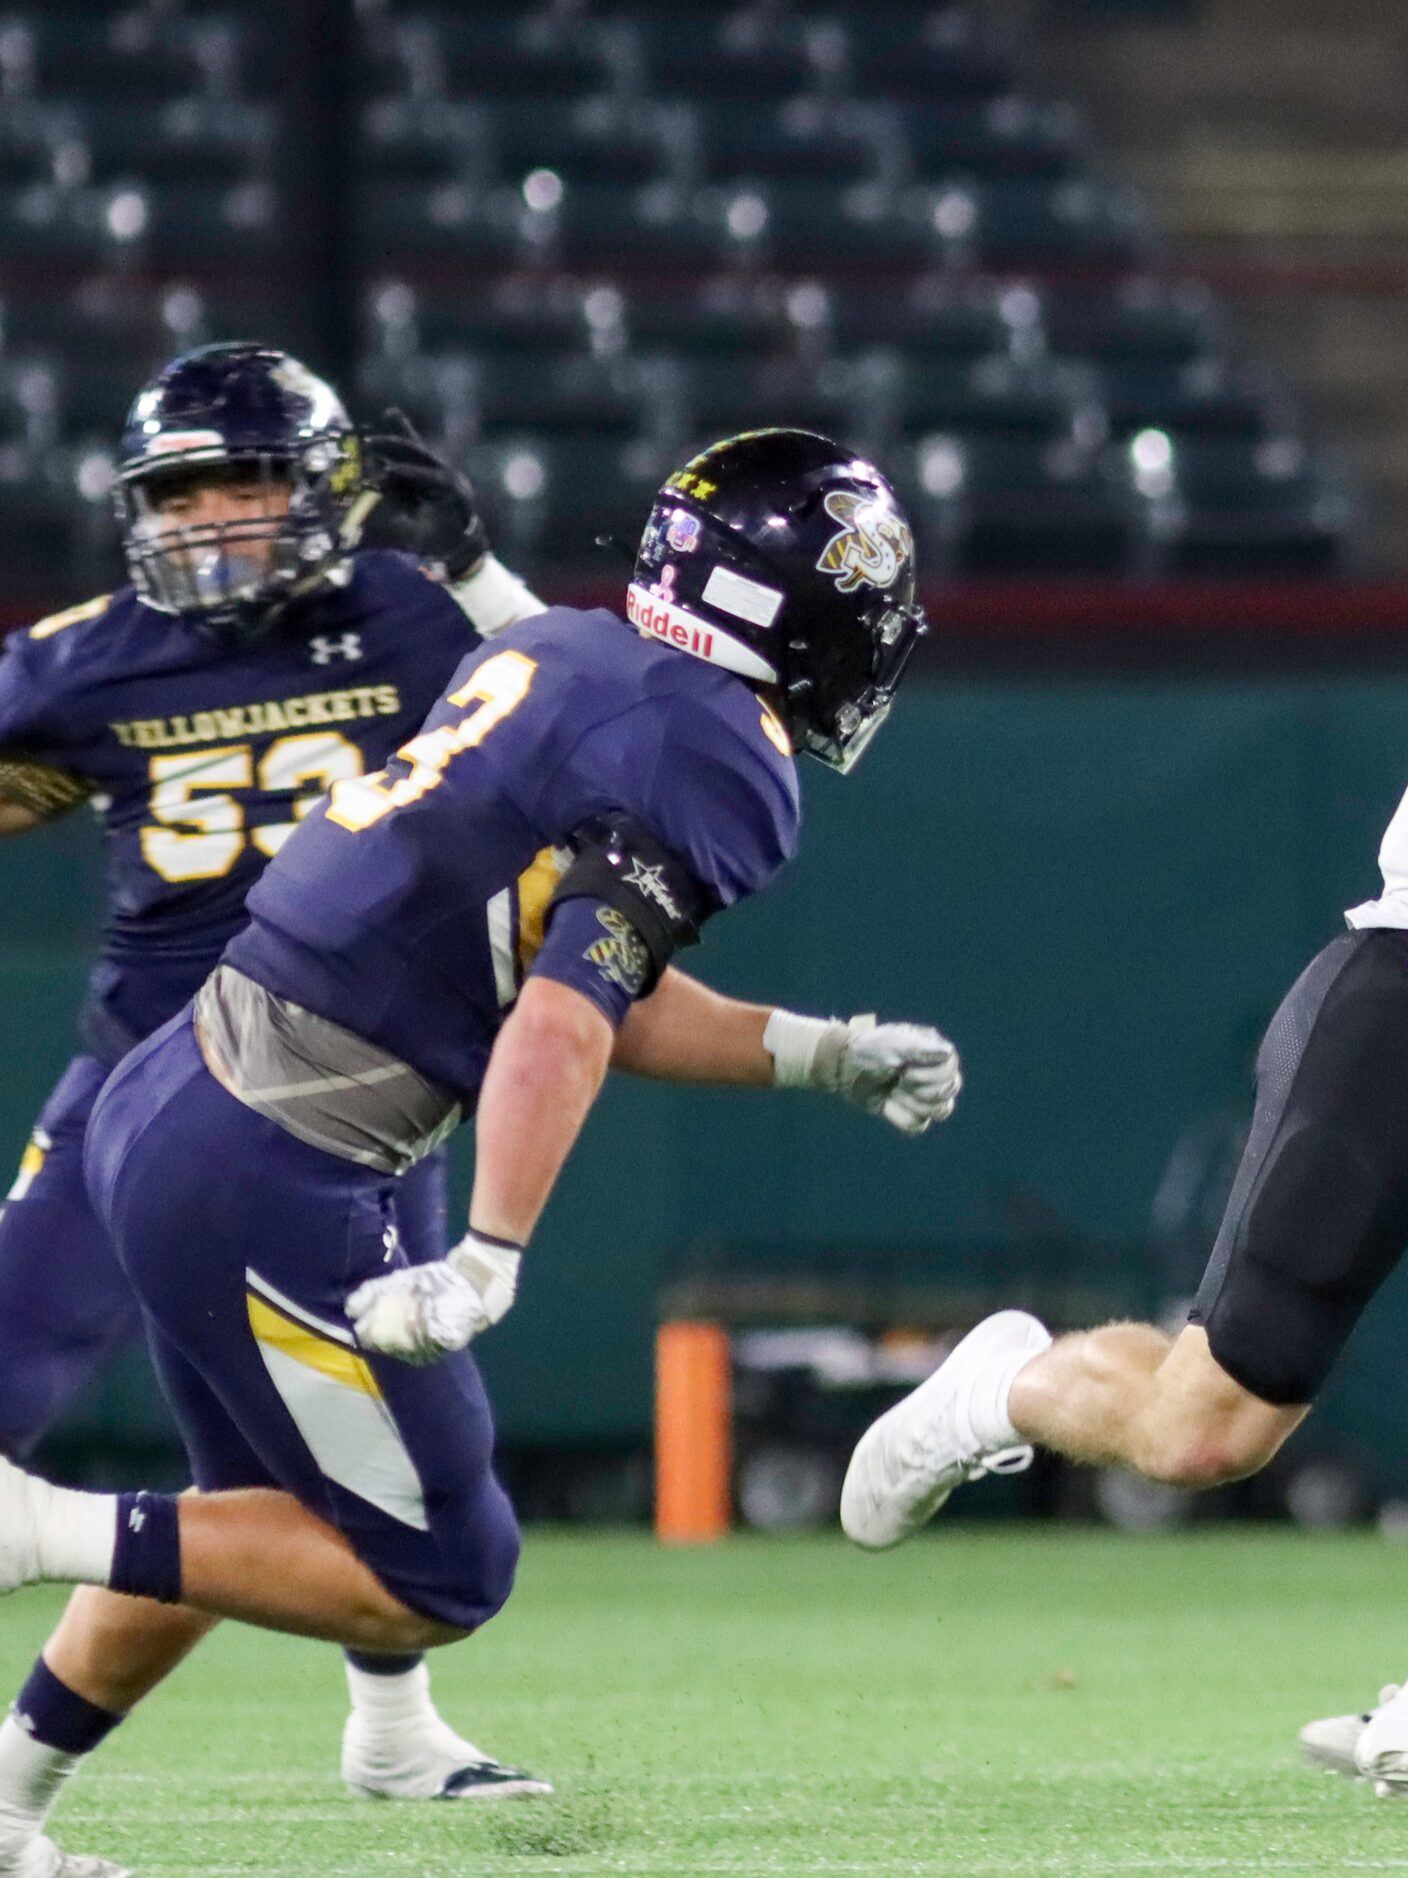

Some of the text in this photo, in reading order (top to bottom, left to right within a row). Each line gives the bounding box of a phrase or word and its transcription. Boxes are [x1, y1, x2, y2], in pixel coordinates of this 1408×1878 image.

[626, 590, 714, 658] Riddell
[108, 684, 401, 748] YELLOWJACKETS
[324, 649, 539, 833] 3
[139, 730, 365, 882] 53
